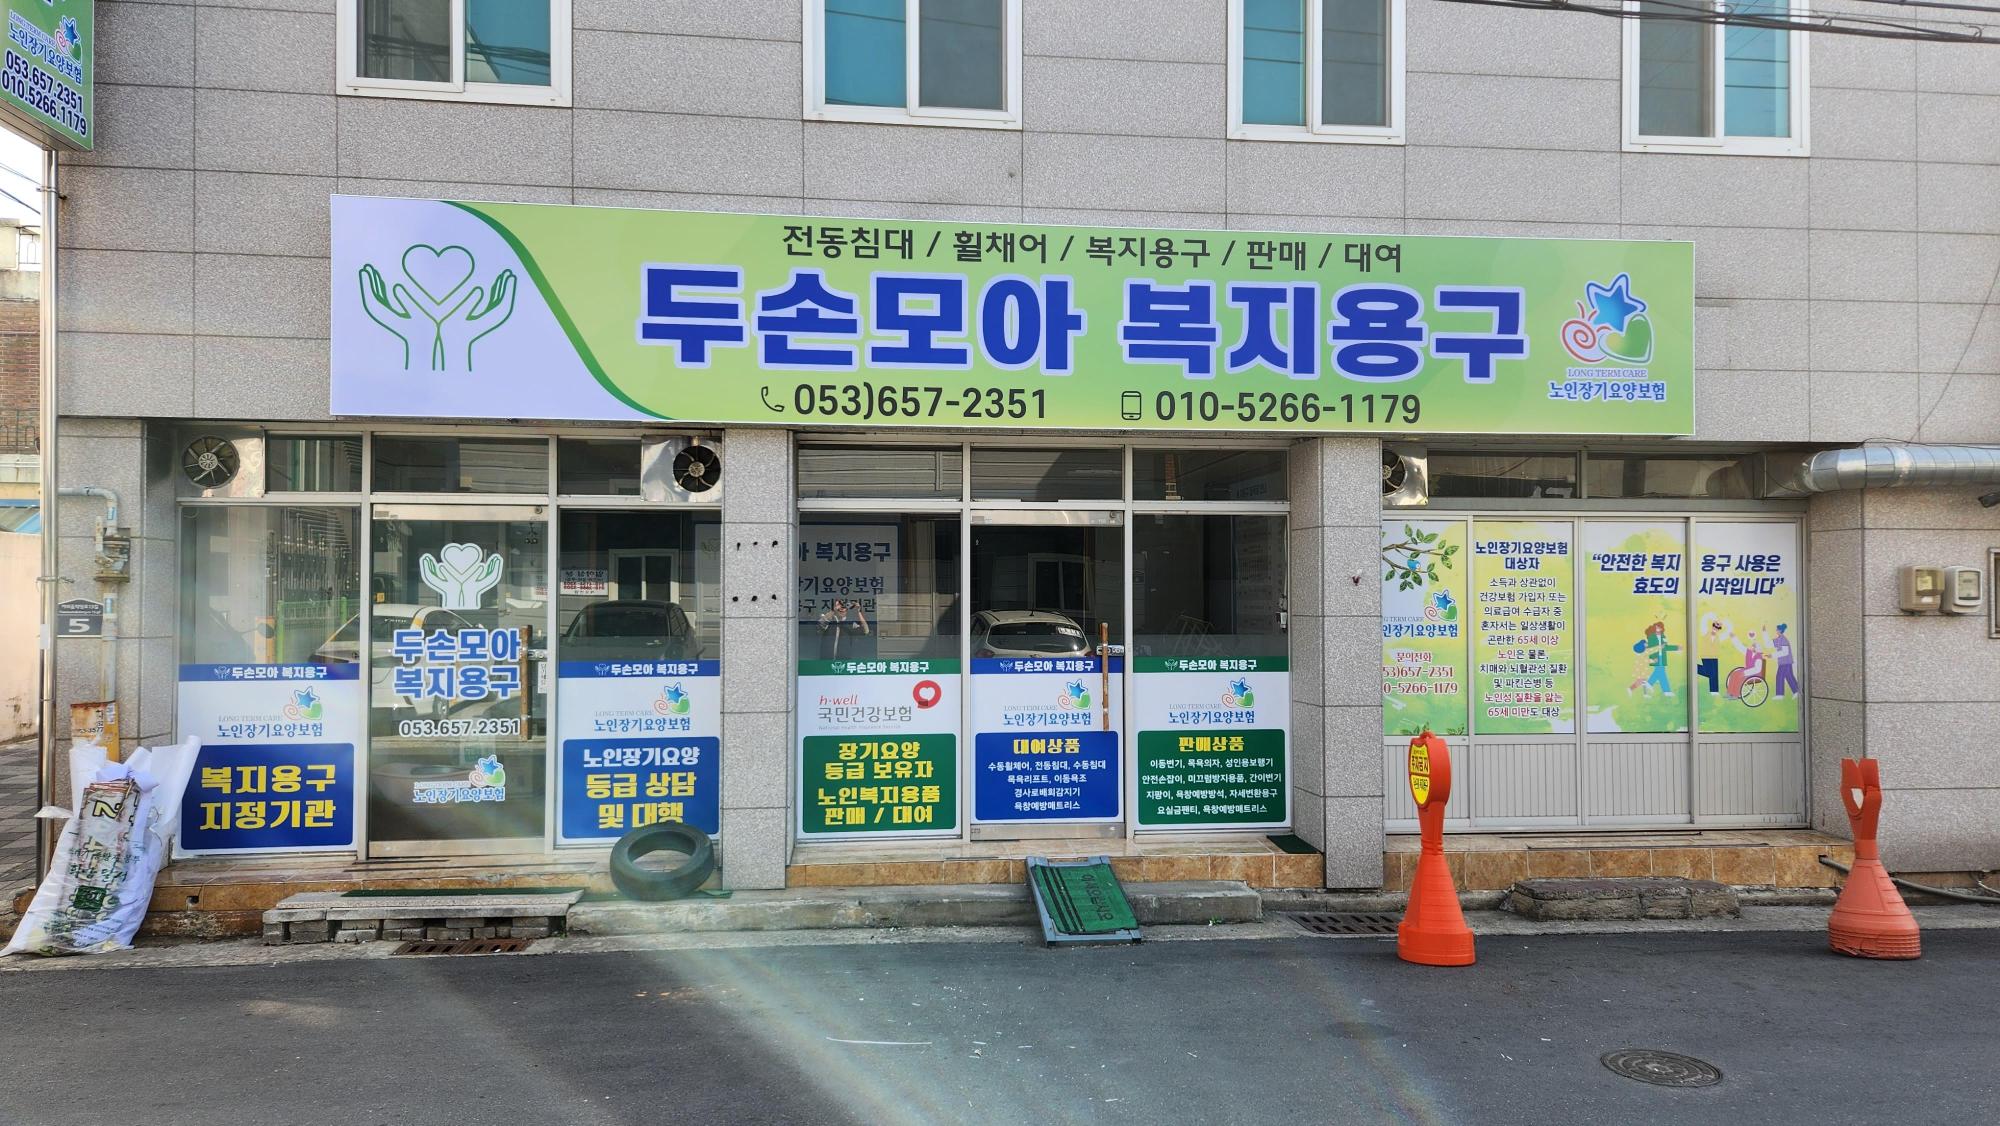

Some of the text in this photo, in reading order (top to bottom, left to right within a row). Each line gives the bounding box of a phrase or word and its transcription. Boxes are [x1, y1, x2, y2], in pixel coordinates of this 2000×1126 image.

[9, 22, 82, 85] 노인장기요양보험
[6, 49, 83, 114] 053.657.2351
[2, 69, 87, 137] 010.5266.1179
[782, 225, 1403, 274] 전동침대 / 휠채어 / 복지용구 / 판매 / 대여
[640, 266, 1527, 381] 두손모아 복지용구
[1567, 368, 1648, 379] LONG TERM CARE
[1549, 381, 1666, 401] 노인장기요양보험
[794, 382, 1046, 420] 053)657-2351
[1155, 391, 1421, 424] 010-5266-1179
[816, 542, 891, 562] 복지용구
[1475, 541, 1568, 555] 노인장기요양보험
[1505, 557, 1540, 570] 대상자
[1651, 554, 1681, 571] 복지
[1701, 554, 1732, 572] 용구
[1735, 554, 1781, 572] 사용은
[799, 576, 884, 596] 기요양보험
[1489, 577, 1556, 588] 소득과 상관없이
[1633, 577, 1679, 594] 효도의
[1480, 591, 1567, 602] 건강보험 가입자 또는
[1484, 606, 1562, 617] 의료급여 수급자 중
[69, 618, 90, 633] 5
[1481, 620, 1565, 631] 혼자서는 일상생활이
[394, 629, 521, 663] 두손모아
[1488, 635, 1559, 645] 곤란한 65세 이상
[1396, 652, 1432, 663] 문의전화
[1498, 649, 1549, 660] 노인은 물론,
[231, 666, 327, 679] 두손모아 복지용구
[611, 663, 698, 676] 두손모아 복지용구
[846, 662, 930, 674] 두손모아 복지용구
[1014, 660, 1094, 672] 두손모아 복지용구
[1179, 659, 1257, 671] 두손모아 복지용구
[1480, 663, 1568, 674] 치매와 뇌혈관성 질환
[394, 666, 521, 699] 복지용구
[1494, 678, 1554, 689] 및 파킨슨병 등
[1485, 693, 1512, 703] 노인성
[1515, 692, 1542, 703] 질환을
[818, 705, 912, 723] 국민건강보험
[1168, 710, 1255, 725] 노인장기요양보험
[1488, 706, 1560, 717] 65세 미만도 대상
[594, 718, 691, 732] 노인장기요양보험
[1003, 712, 1092, 727] 노인장기요양보험
[217, 723, 323, 738] 노인장기요양보험
[400, 719, 520, 738] 053.657.2351
[839, 741, 921, 760] 장기요양
[1013, 738, 1081, 754] 대여상품
[1178, 736, 1245, 752] 판매상품
[583, 747, 700, 768] 노인장기요양
[1150, 758, 1274, 769] 이동변기, 목욕의자, 성인용보행기
[825, 760, 934, 780] 등급 보유자
[1035, 760, 1071, 771] 전동침대,
[1073, 760, 1106, 770] 수동침대
[201, 765, 336, 794] 복지용구
[587, 772, 697, 799] 등급 상담
[1007, 774, 1087, 784] 목욕리프트, 이동욕조
[1142, 774, 1186, 785] 안전손잡이,
[1249, 773, 1282, 783] 간이변기
[414, 787, 505, 803] 노인장기요양보험
[818, 785, 940, 805] 노인복지용품
[1014, 787, 1081, 798] 경사로배회감지기
[1229, 788, 1278, 798] 자세변환용구
[1014, 801, 1081, 811] 욕창예방매트리스
[1157, 804, 1268, 815] 요실금팬티, 욕창예방매트리스
[200, 799, 336, 831] 지정기관
[599, 802, 684, 829] 및 대행
[825, 805, 933, 826] 판매 / 대여
